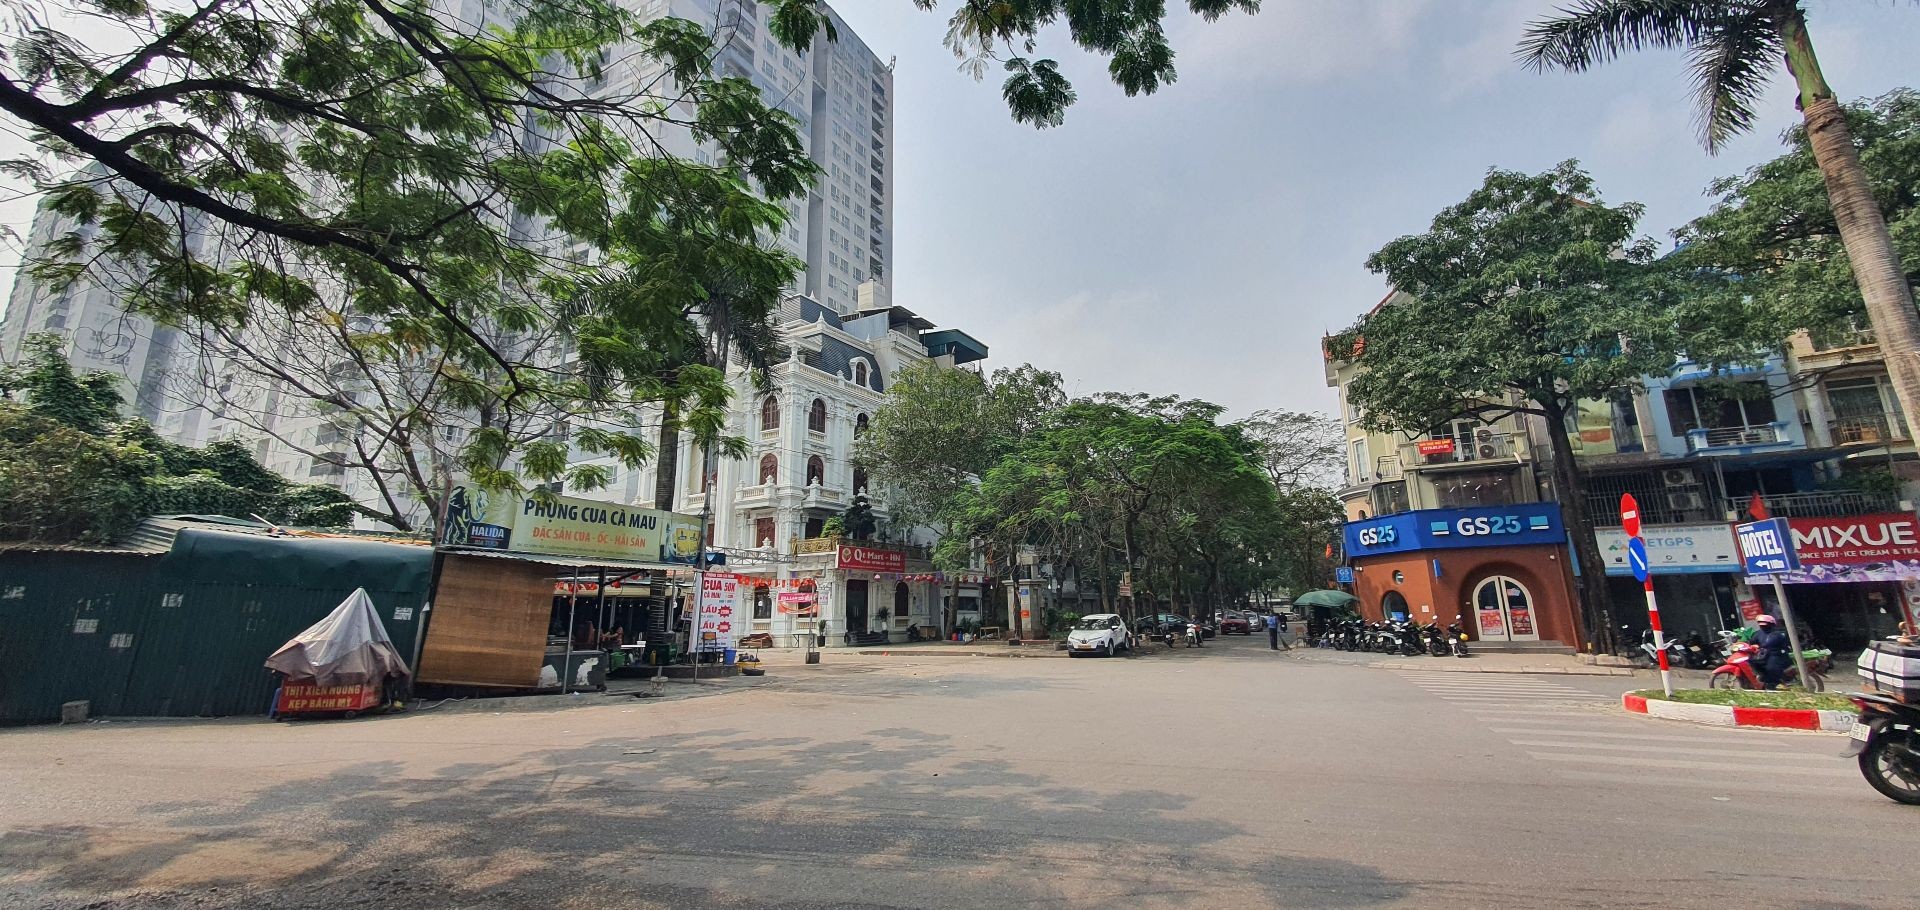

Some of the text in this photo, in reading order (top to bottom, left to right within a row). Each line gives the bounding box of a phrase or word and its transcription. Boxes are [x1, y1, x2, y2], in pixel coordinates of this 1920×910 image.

[524, 499, 657, 530] PHỤNG CUA CÀ MAU
[471, 525, 505, 538] HALIDA
[533, 525, 552, 541] ĐẶC
[574, 531, 591, 542] CUA
[1457, 516, 1522, 536] GS25
[1359, 525, 1395, 546] GS25
[1646, 537, 1694, 549] ETGPS
[1791, 522, 1918, 550] MIXUE
[1740, 530, 1783, 558] HOTEL
[867, 552, 884, 560] Mart
[1859, 549, 1890, 557] CREAM
[1901, 547, 1920, 555] TEA
[1338, 568, 1350, 576] GS
[703, 579, 723, 591] CUA
